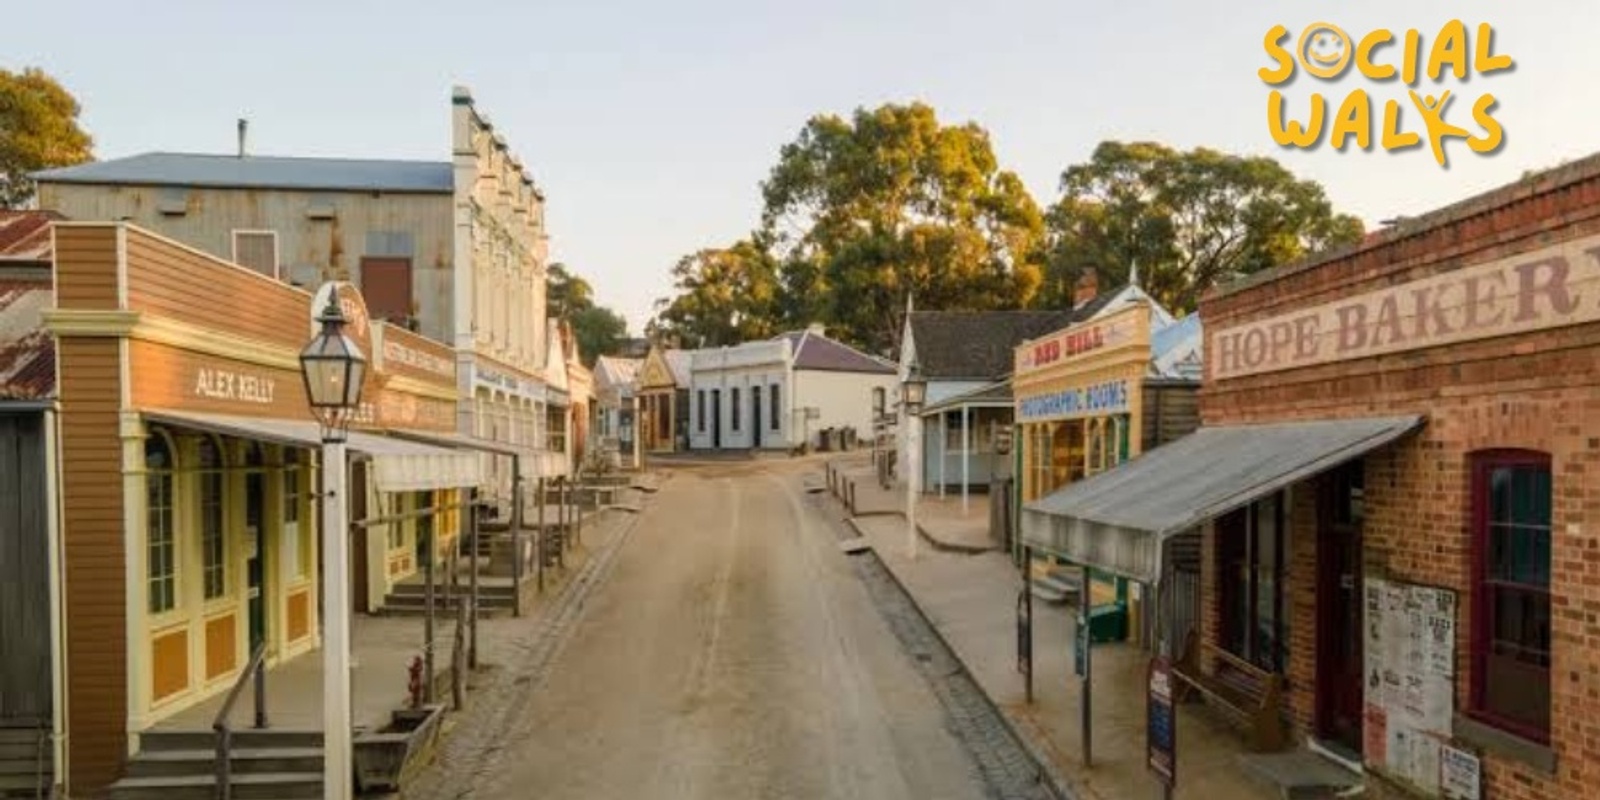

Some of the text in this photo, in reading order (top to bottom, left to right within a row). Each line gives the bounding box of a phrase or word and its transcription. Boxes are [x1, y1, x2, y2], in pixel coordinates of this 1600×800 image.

[1033, 326, 1103, 367] RED HILL
[1218, 312, 1321, 375] HOPE
[195, 368, 275, 403] ALEX KELLY
[1086, 379, 1126, 410] ROOMS
